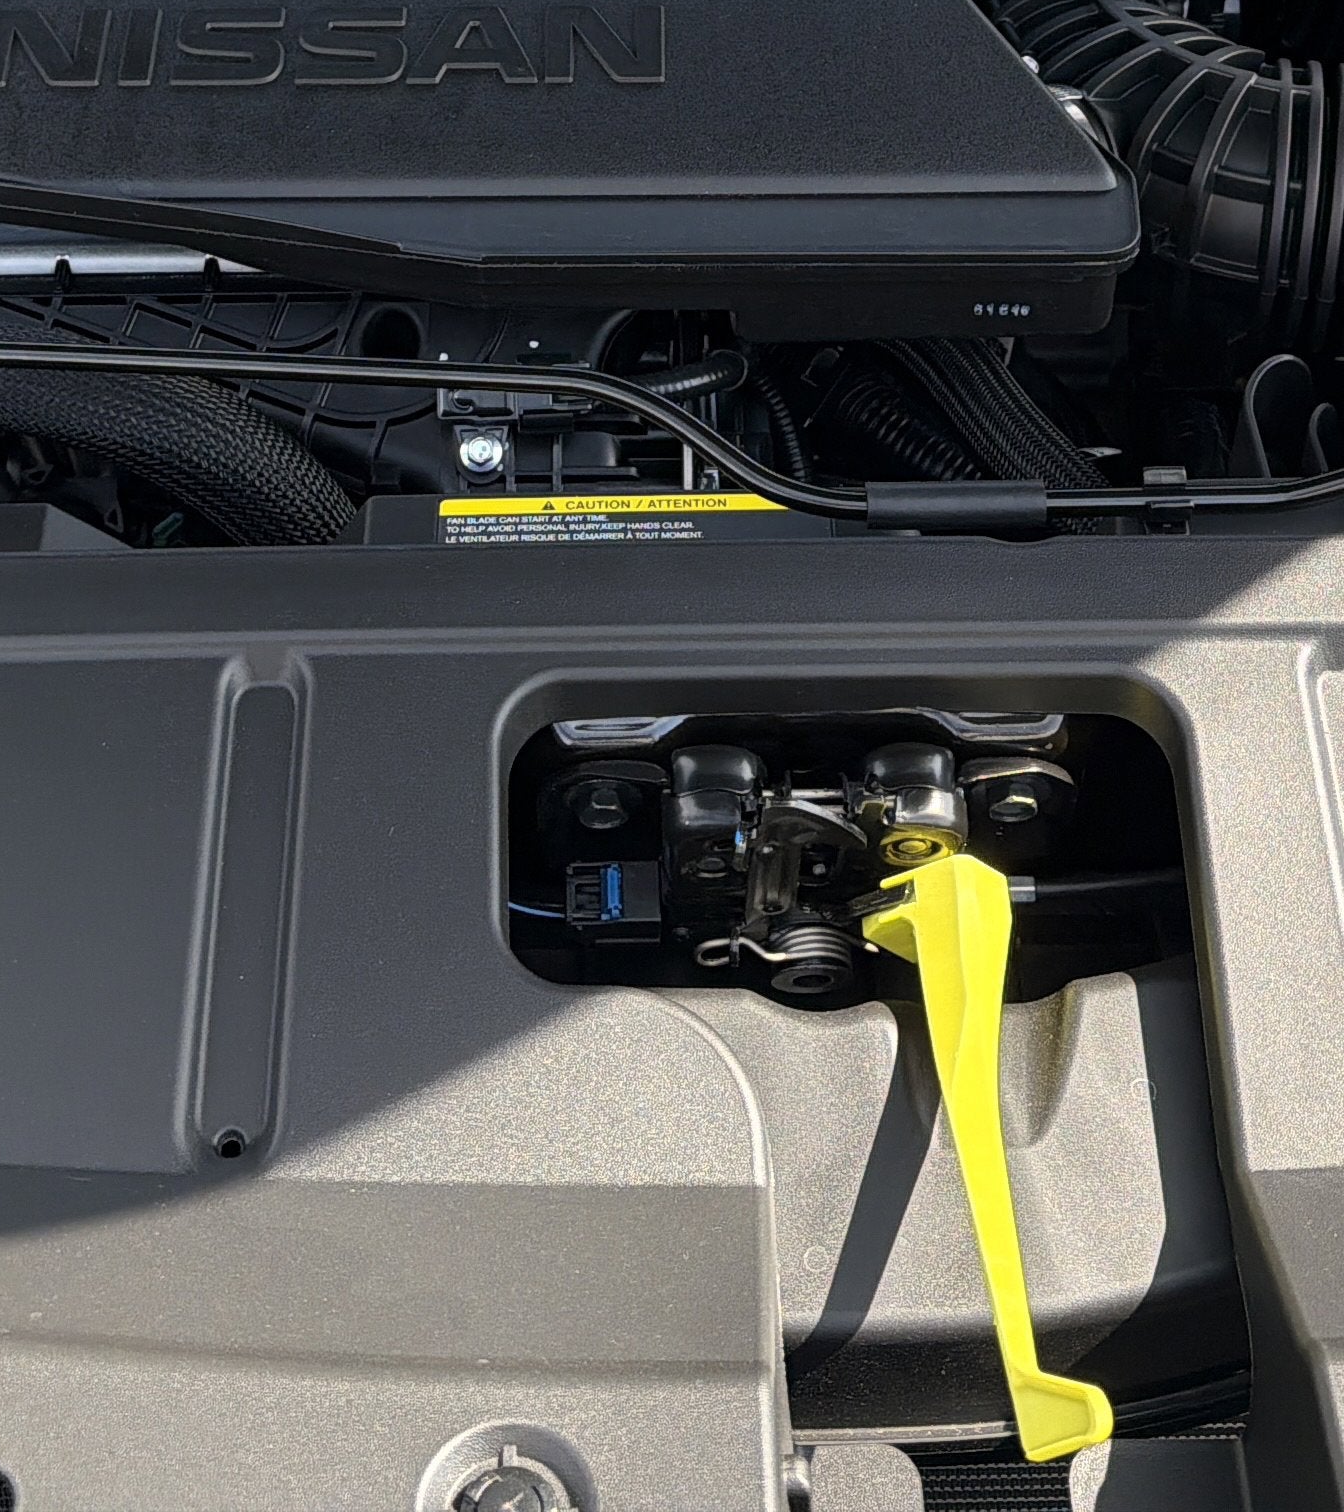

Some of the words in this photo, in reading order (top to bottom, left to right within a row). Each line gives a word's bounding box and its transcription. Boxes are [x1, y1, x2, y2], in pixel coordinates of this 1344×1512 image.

[565, 499, 631, 510] CAUTION
[647, 498, 727, 509] ATTENTION
[446, 517, 465, 525] FAN
[467, 516, 497, 524] BLADE
[499, 516, 519, 524] CAN
[521, 515, 549, 523] START
[551, 515, 562, 523] AT
[461, 525, 486, 533] HELP
[487, 525, 516, 533] AVOID
[517, 524, 567, 532] PERSONAL
[627, 522, 660, 530] HANDS
[445, 536, 456, 544] LE
[458, 535, 519, 543] VENTILATEUR
[521, 534, 556, 542] RISQUE
[558, 533, 570, 541] DE
[573, 531, 624, 541] DÉMARRER
